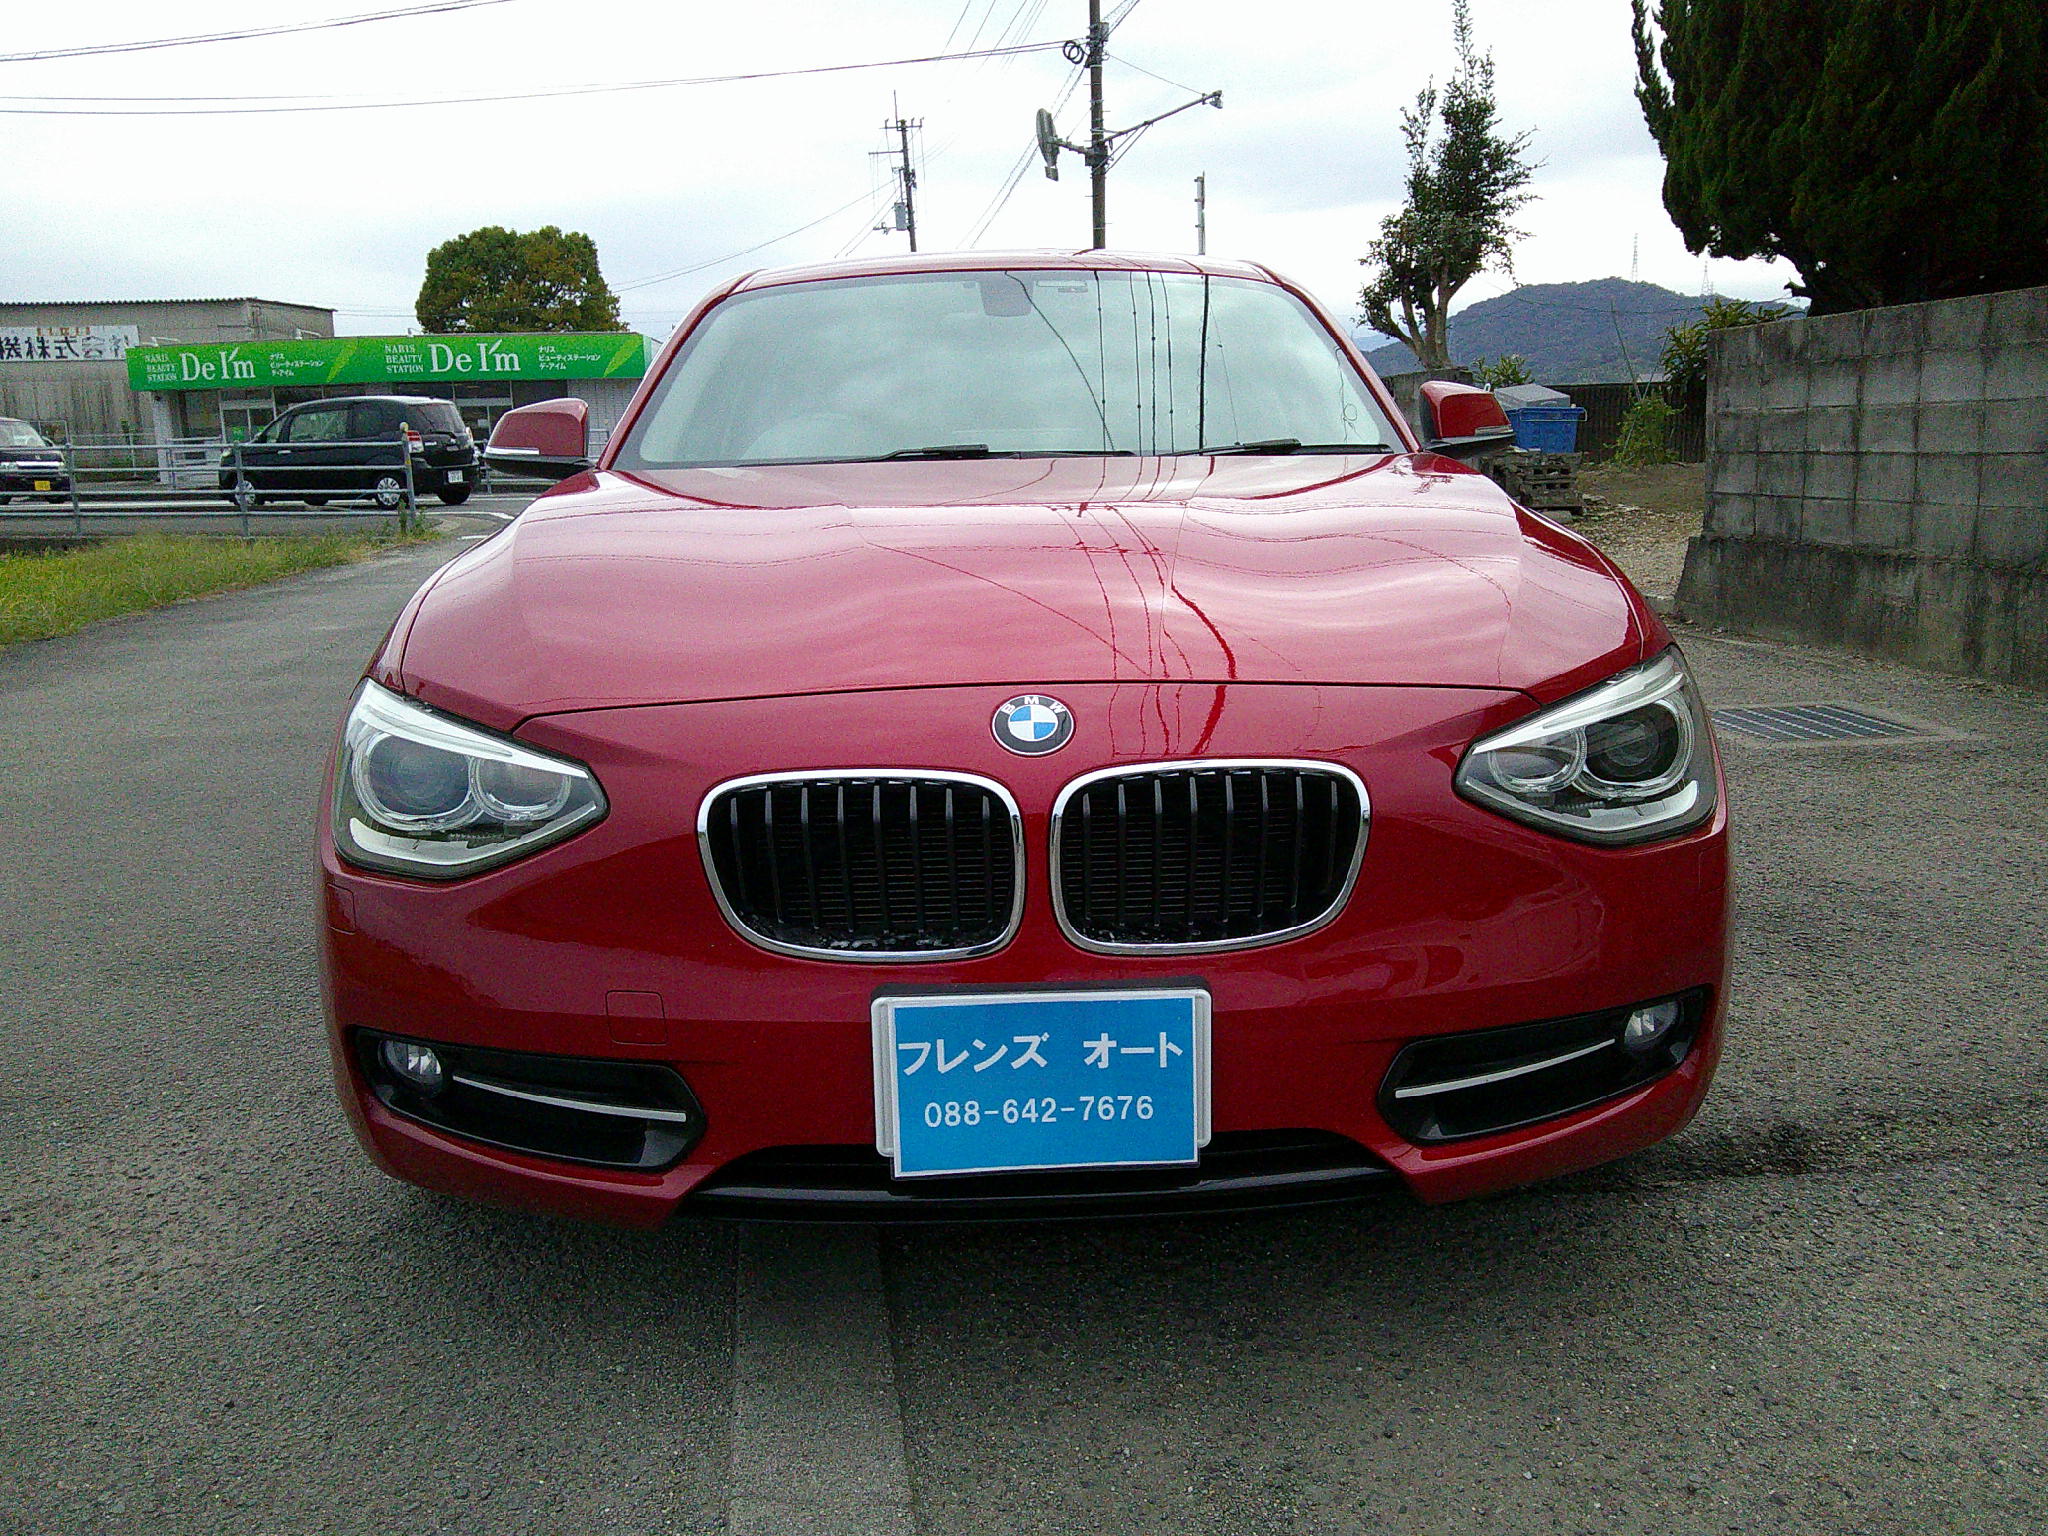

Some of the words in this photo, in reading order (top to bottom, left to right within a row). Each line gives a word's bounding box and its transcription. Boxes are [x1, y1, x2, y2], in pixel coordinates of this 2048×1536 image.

[384, 344, 416, 353] NARIS
[428, 343, 472, 373] De
[179, 352, 216, 381] De
[385, 354, 422, 364] BEAUTY
[147, 373, 177, 382] STATION
[386, 364, 424, 374] STATION
[1000, 696, 1066, 715] BMW
[898, 1032, 1050, 1076] フレンズ
[1083, 1031, 1183, 1069] オート
[924, 1095, 1154, 1128] 088-642-7676
